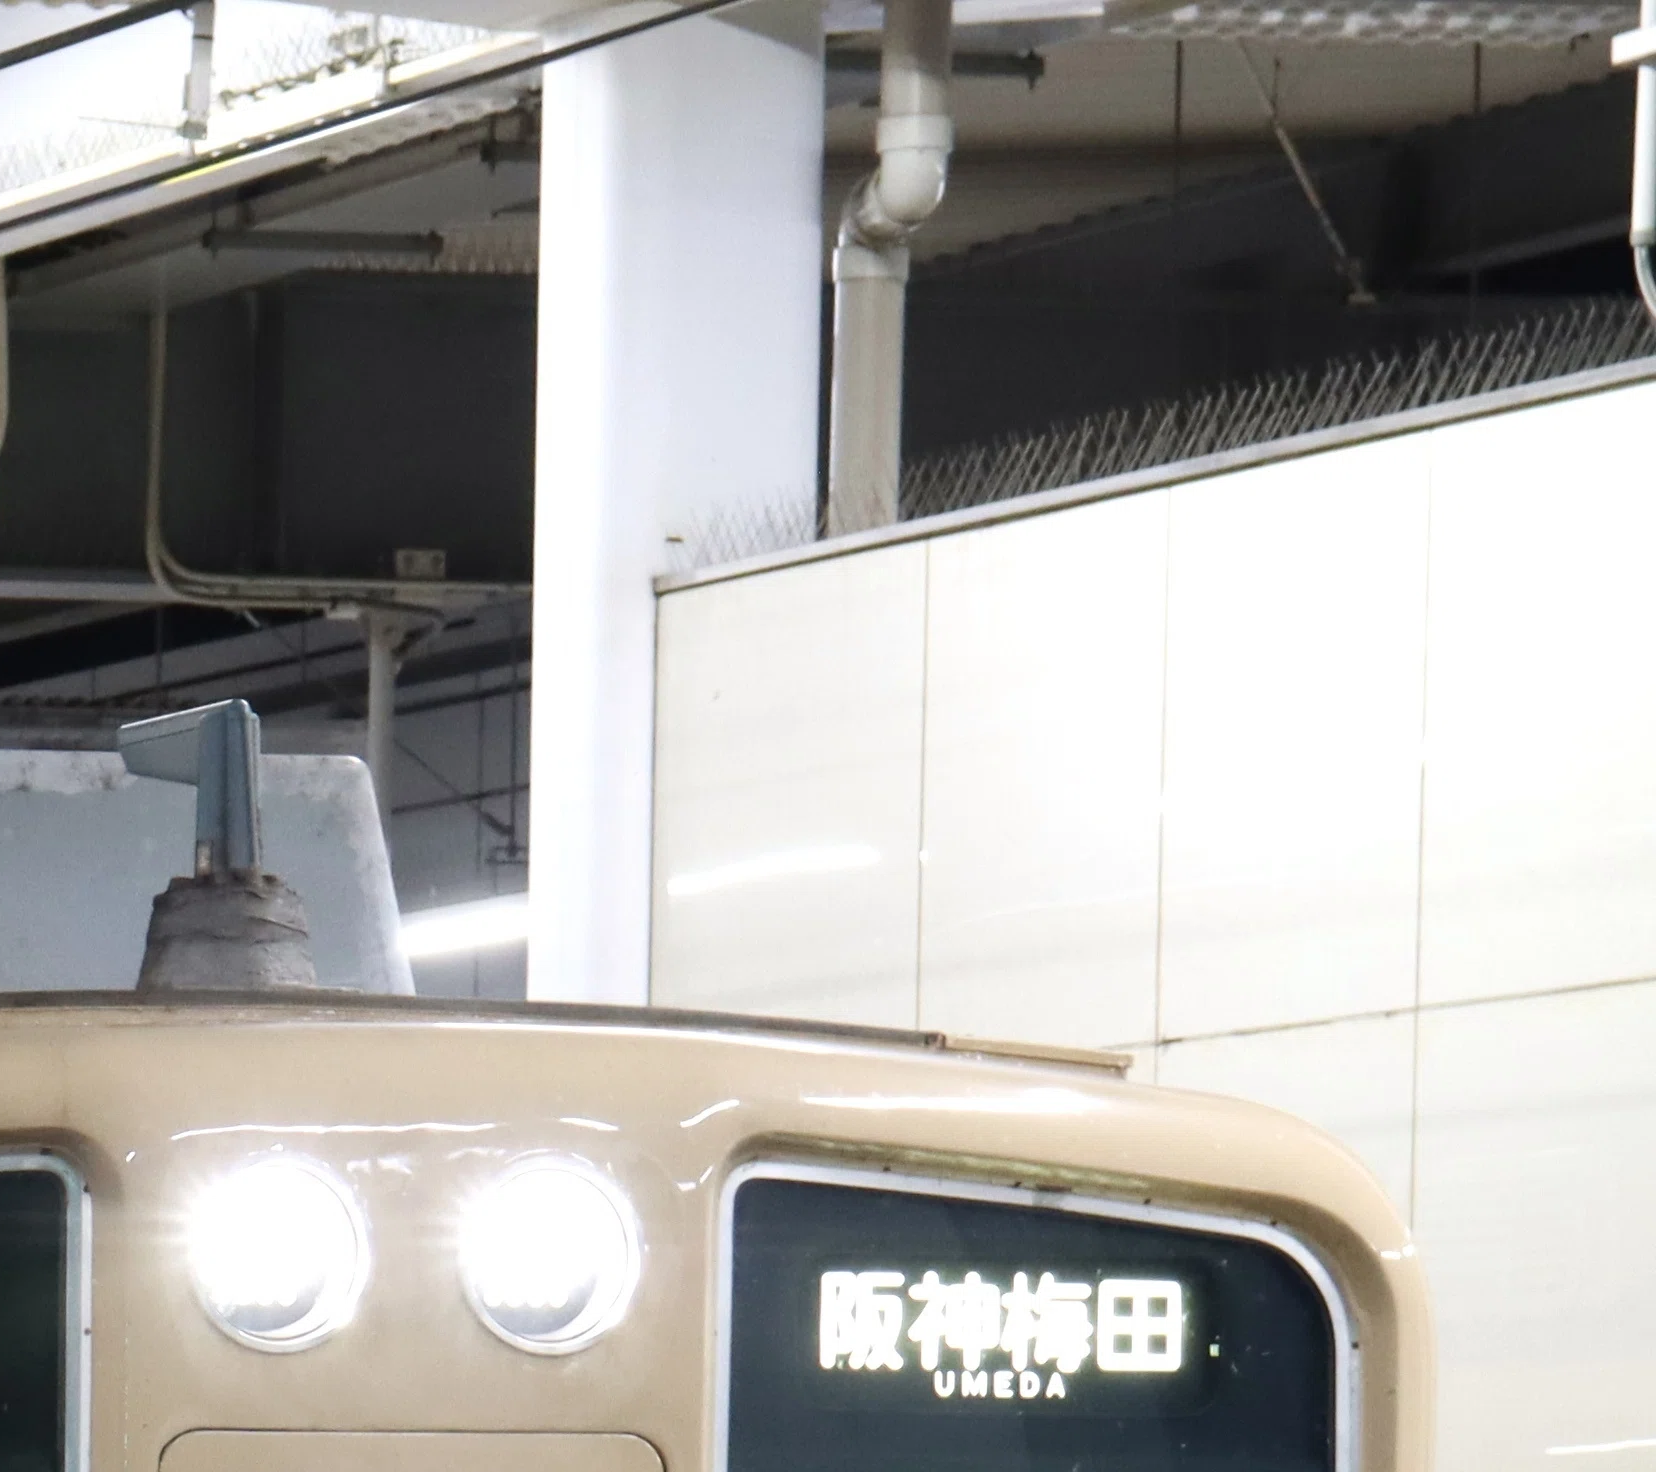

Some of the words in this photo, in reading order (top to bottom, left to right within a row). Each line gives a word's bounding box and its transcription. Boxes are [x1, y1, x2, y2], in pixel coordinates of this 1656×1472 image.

[817, 1269, 1184, 1374] 阪神梅田
[932, 1369, 1068, 1400] UMEDA
